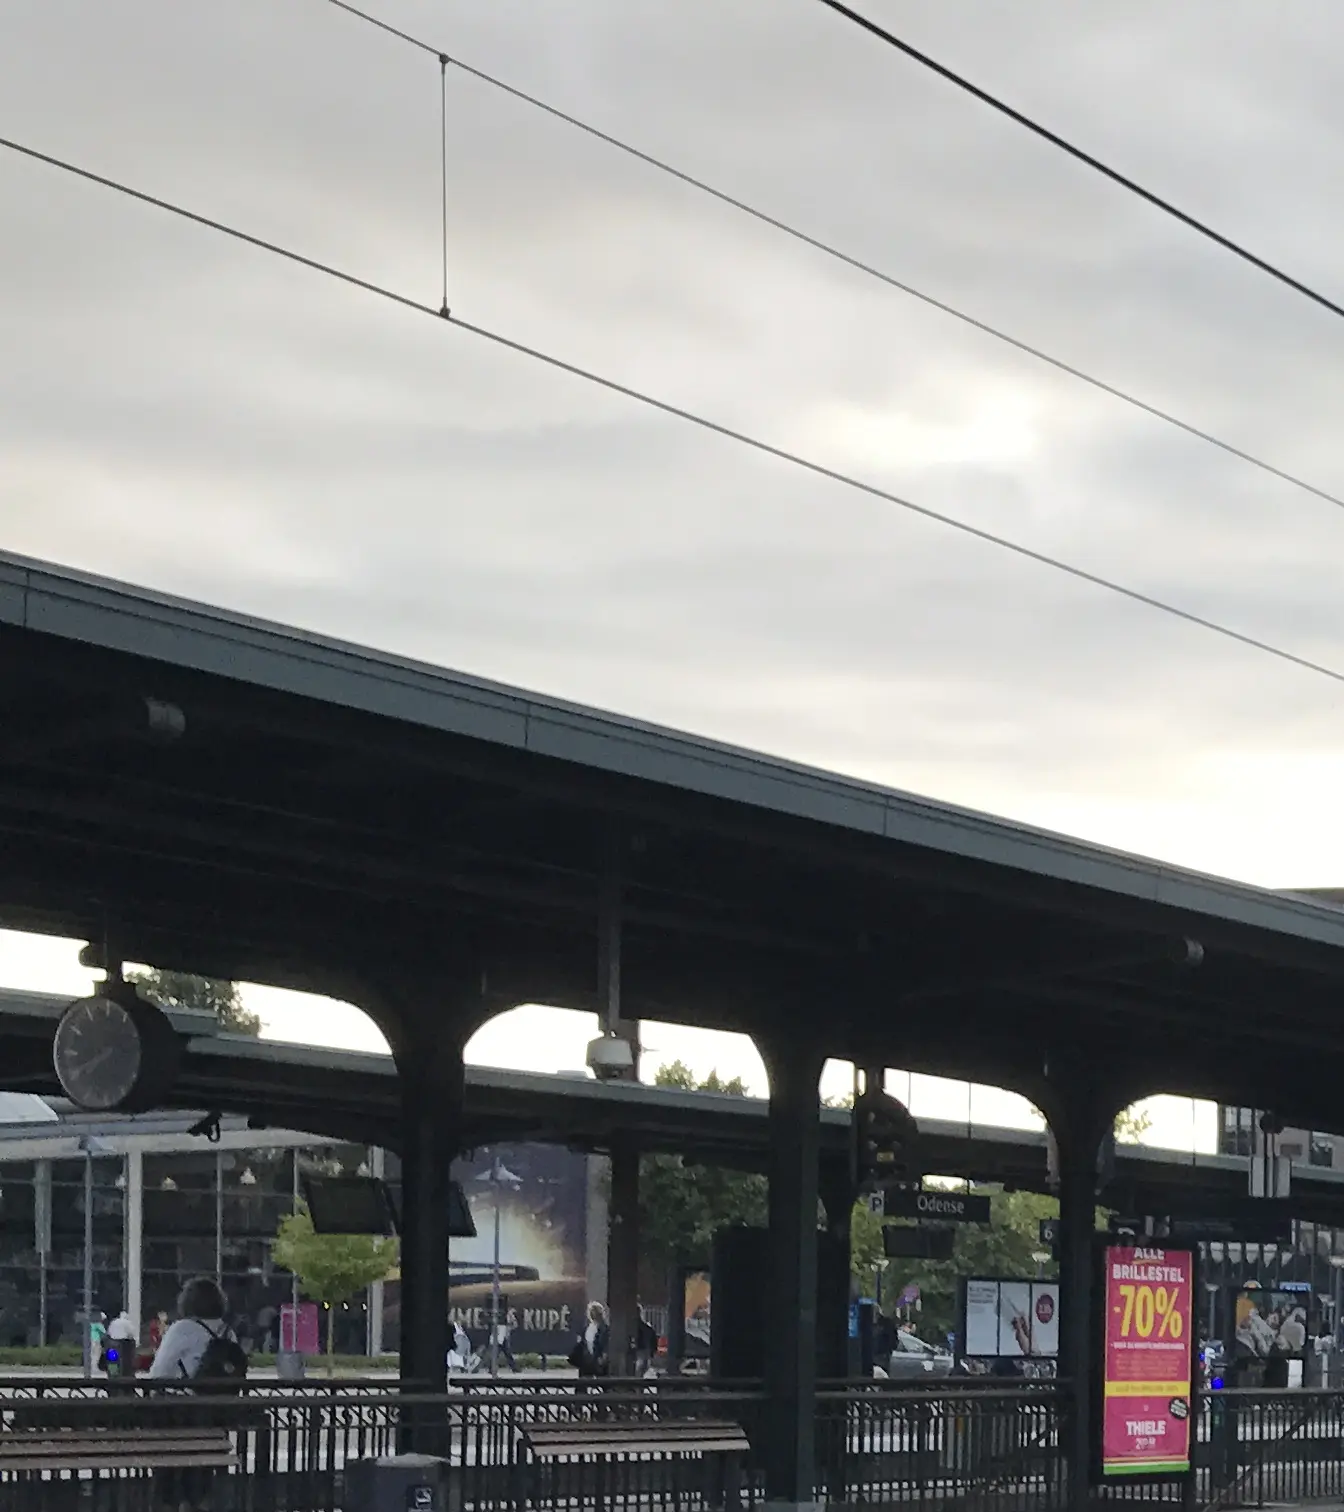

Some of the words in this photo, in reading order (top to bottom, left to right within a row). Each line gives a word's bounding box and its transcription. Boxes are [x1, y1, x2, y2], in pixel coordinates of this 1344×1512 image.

[917, 1195, 965, 1214] Odense
[1134, 1247, 1165, 1260] ALLE
[1112, 1264, 1185, 1283] BRILLESTEL
[523, 1303, 571, 1331] KUPÉ
[1113, 1284, 1183, 1338] -70%
[1126, 1420, 1167, 1436] THIELE
